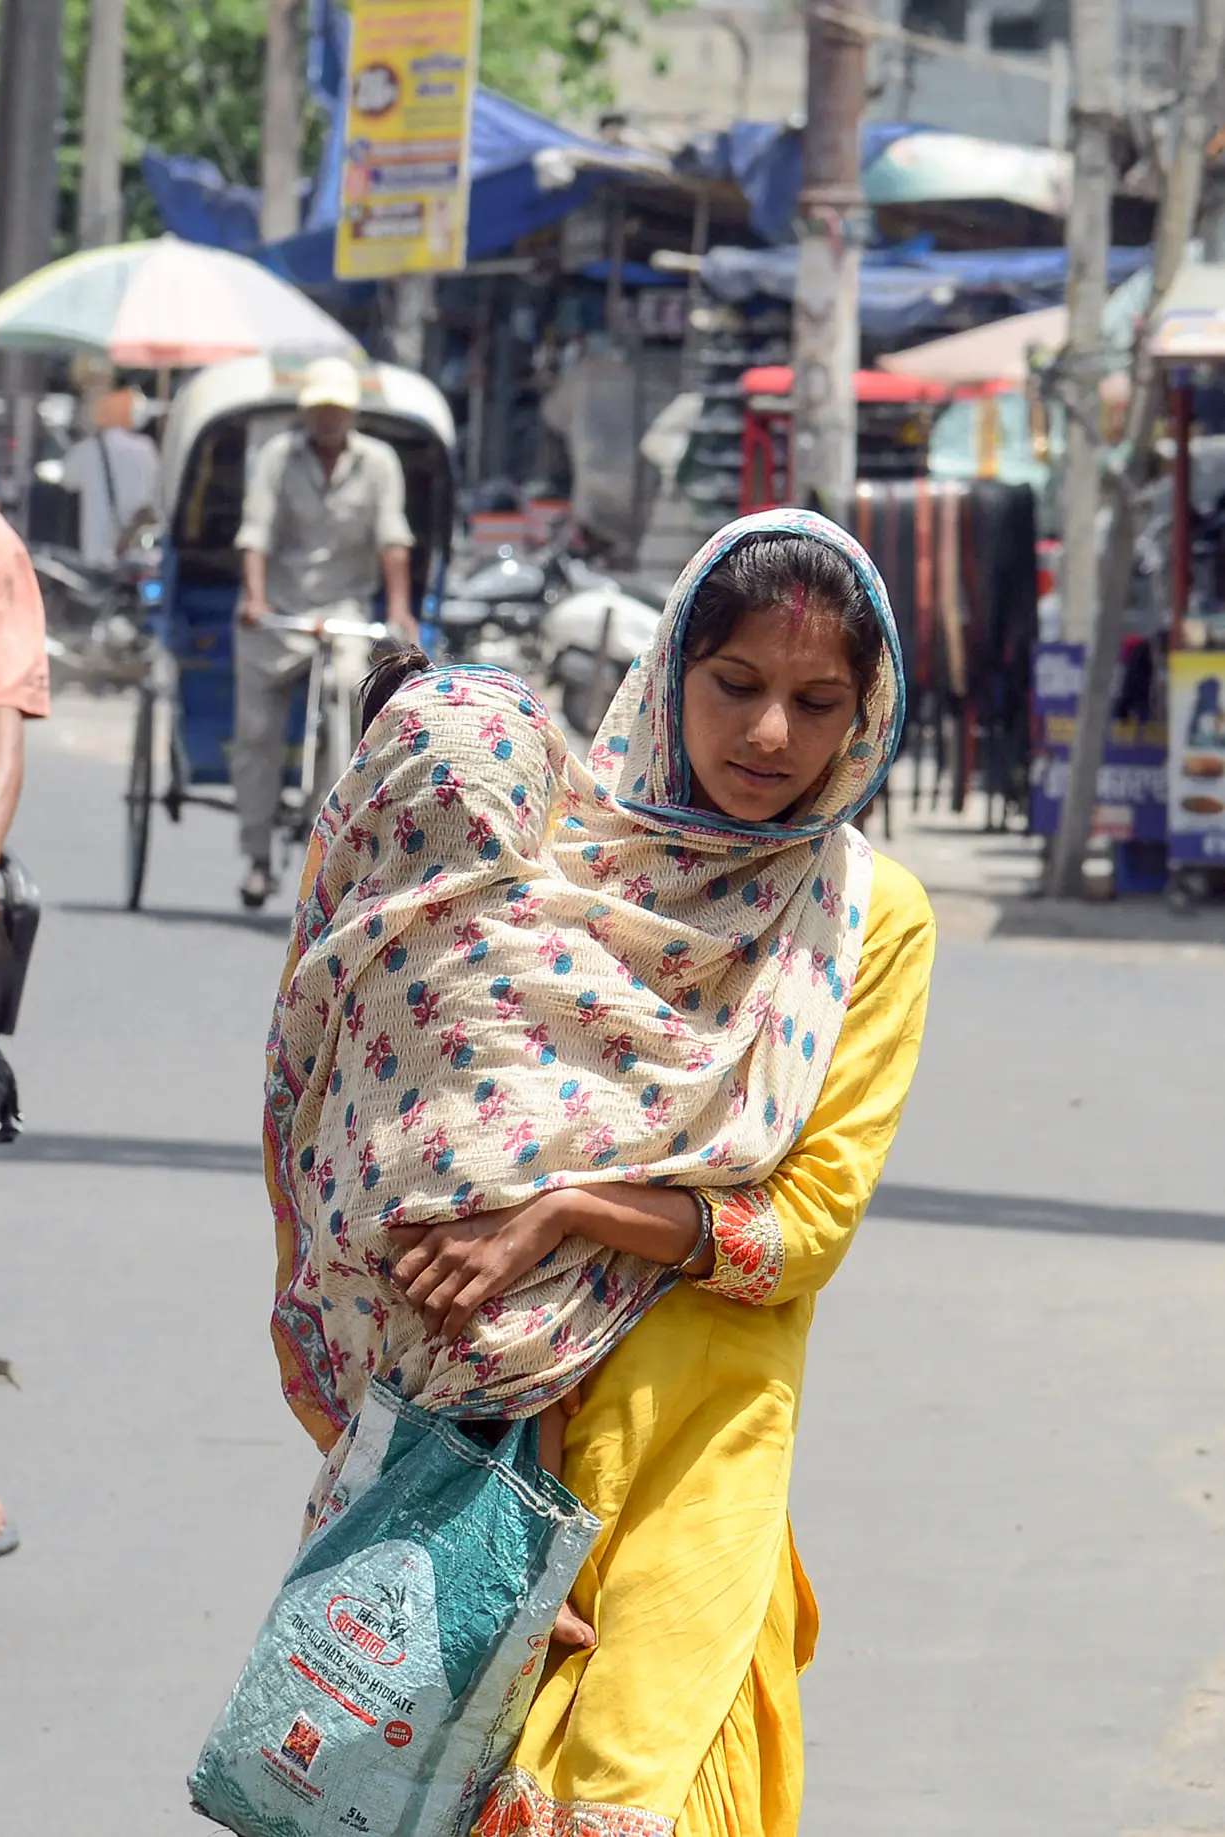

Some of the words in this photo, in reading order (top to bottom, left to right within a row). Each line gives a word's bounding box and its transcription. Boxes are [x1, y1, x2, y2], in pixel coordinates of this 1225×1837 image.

[292, 1614, 309, 1635] ZINC
[308, 1628, 346, 1667] SULPHATE
[386, 1731, 409, 1741] QUALITY
